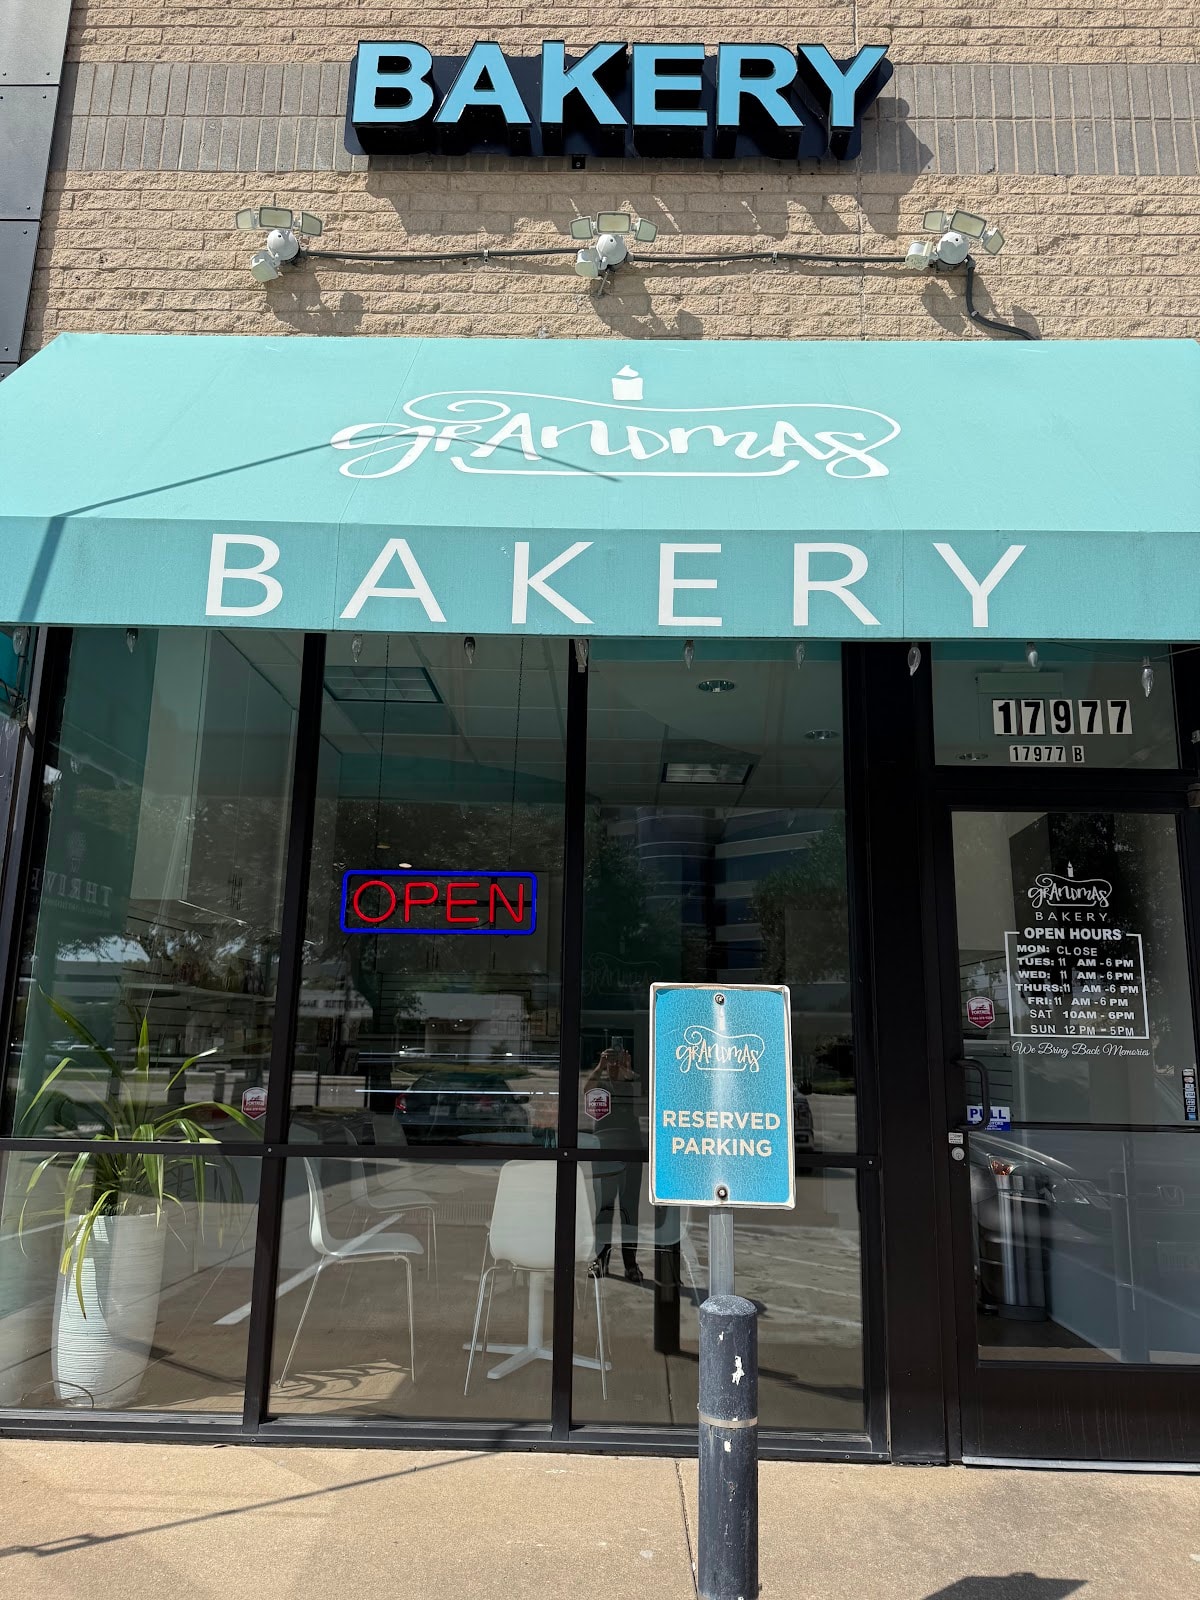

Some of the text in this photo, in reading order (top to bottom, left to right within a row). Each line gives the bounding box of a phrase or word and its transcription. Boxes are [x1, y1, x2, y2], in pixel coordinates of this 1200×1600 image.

[351, 40, 888, 128] BAKERY
[204, 533, 1027, 629] BAKERY
[997, 700, 1128, 734] 17977
[1012, 746, 1083, 762] 17977 B
[352, 880, 524, 923] OPEN
[1035, 911, 1108, 922] BAKERY
[1023, 926, 1122, 941] OPEN HOURS
[1016, 944, 1098, 957] MON: CLOSE
[1016, 958, 1054, 967] TUES:
[1058, 958, 1067, 967] 11
[1077, 958, 1096, 967] AM
[1115, 959, 1134, 968] PM
[1018, 970, 1051, 979] WED:
[1077, 971, 1096, 980] AM
[1115, 972, 1134, 981] PM
[1082, 984, 1101, 993] AM
[1120, 985, 1139, 994] PM
[1027, 996, 1052, 1005] FRI:
[1071, 997, 1091, 1006] AM
[1109, 998, 1128, 1007] PM
[1029, 1009, 1053, 1019] SAT
[1063, 1010, 1097, 1019] 10AM
[1108, 1011, 1135, 1020] 6PM
[1030, 1024, 1056, 1034] SUN
[1011, 1041, 1151, 1059] We Bring Back Memories
[662, 1110, 781, 1130] RESERVED
[671, 1137, 772, 1157] PARKING
